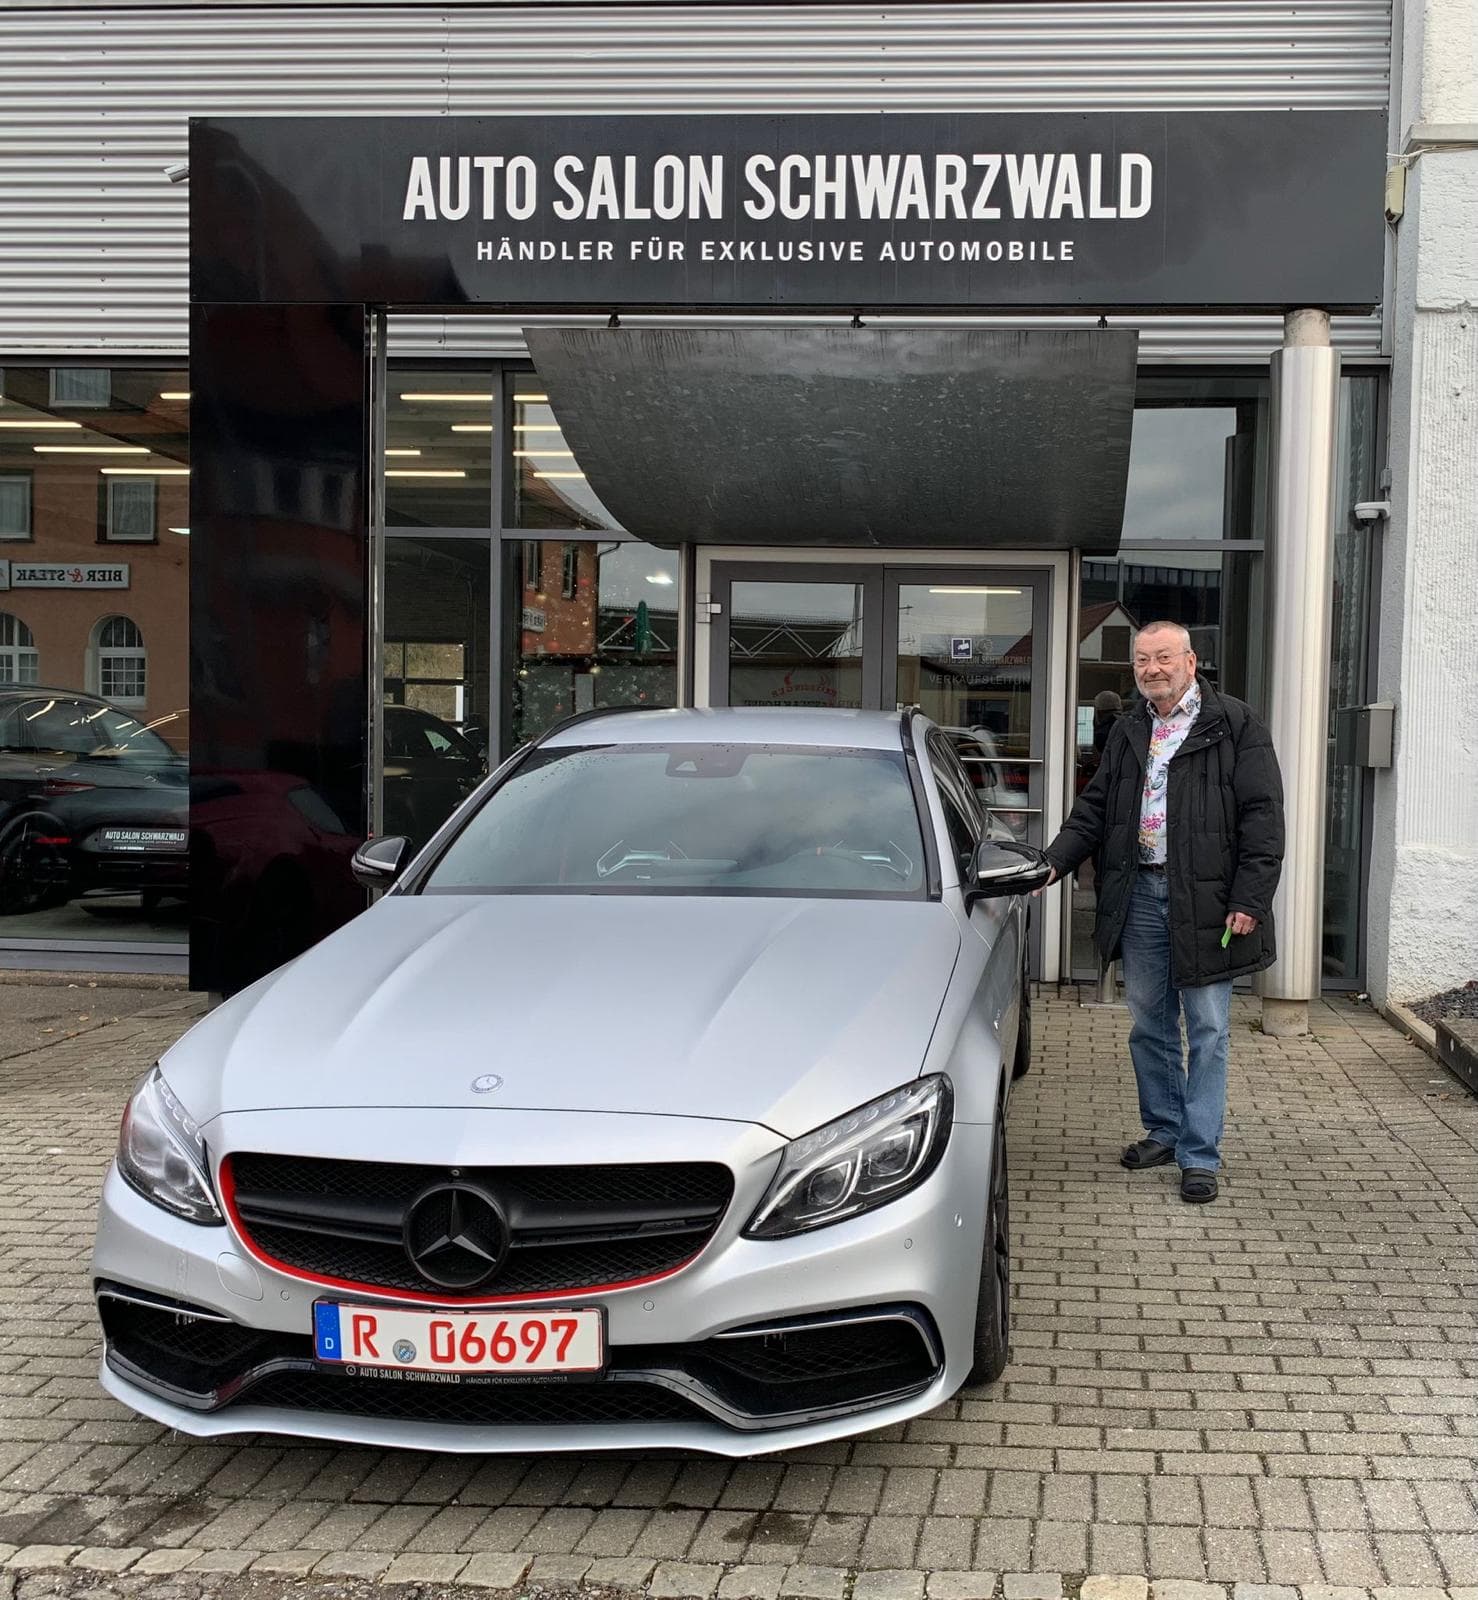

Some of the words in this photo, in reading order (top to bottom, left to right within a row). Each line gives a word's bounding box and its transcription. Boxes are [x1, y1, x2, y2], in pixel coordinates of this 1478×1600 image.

[403, 155, 537, 220] AUTO
[553, 154, 723, 220] SALON
[744, 153, 1152, 220] SCHWARZWALD
[477, 237, 614, 261] HÄNDLER
[630, 236, 684, 261] FÜR
[701, 241, 864, 261] EXKLUSIVE
[880, 240, 1074, 262] AUTOMOBILE
[928, 674, 1033, 686] VERKAUFSLEITUN
[105, 831, 121, 840] AUTO
[121, 831, 140, 840] SALON
[140, 831, 185, 842] SCHWARZWALD
[324, 1337, 335, 1350] D
[352, 1314, 380, 1358] R
[429, 1319, 579, 1364] 06697
[359, 1368, 379, 1378] AUTO
[379, 1369, 403, 1380] SALON
[404, 1371, 461, 1384] SCHWARZWALD
